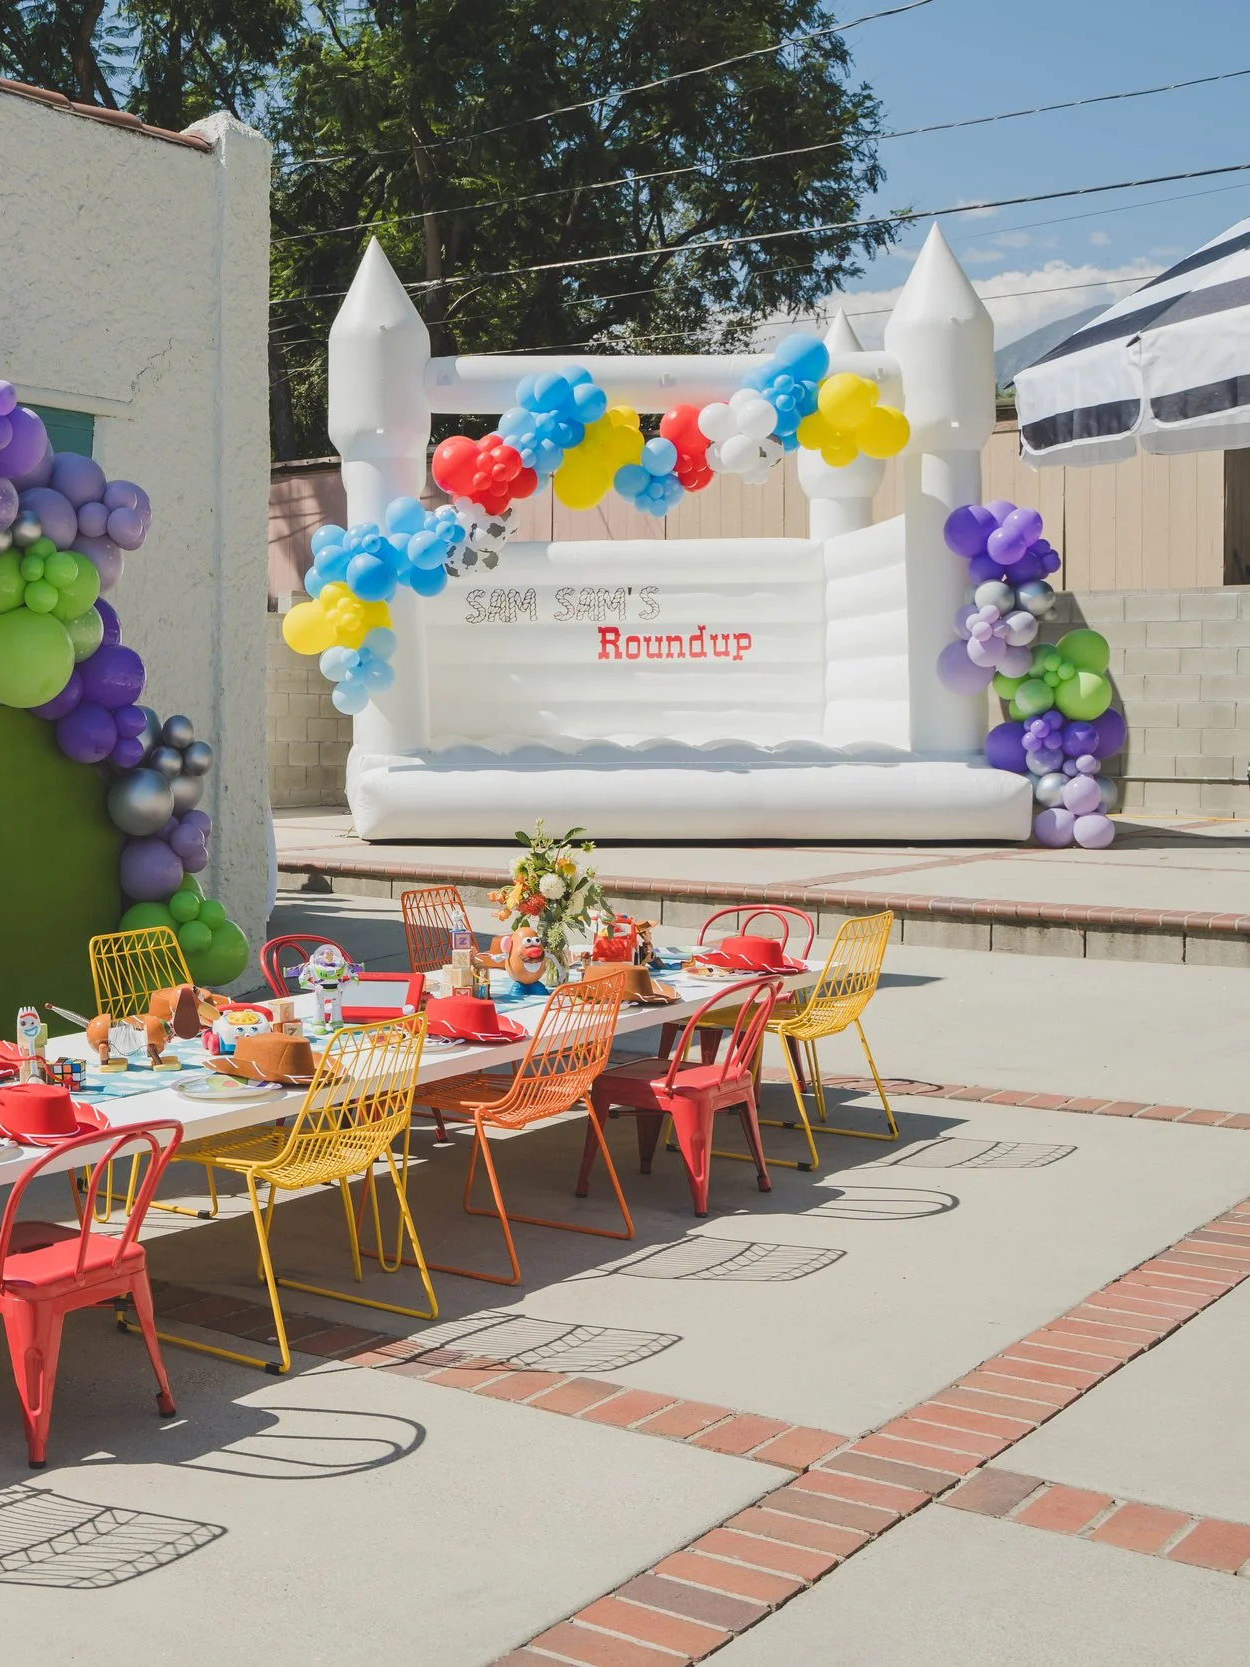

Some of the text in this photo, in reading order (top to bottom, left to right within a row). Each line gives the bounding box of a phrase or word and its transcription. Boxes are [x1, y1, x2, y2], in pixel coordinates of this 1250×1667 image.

[465, 585, 661, 624] SAM SAM'S
[597, 625, 752, 661] Roundup
